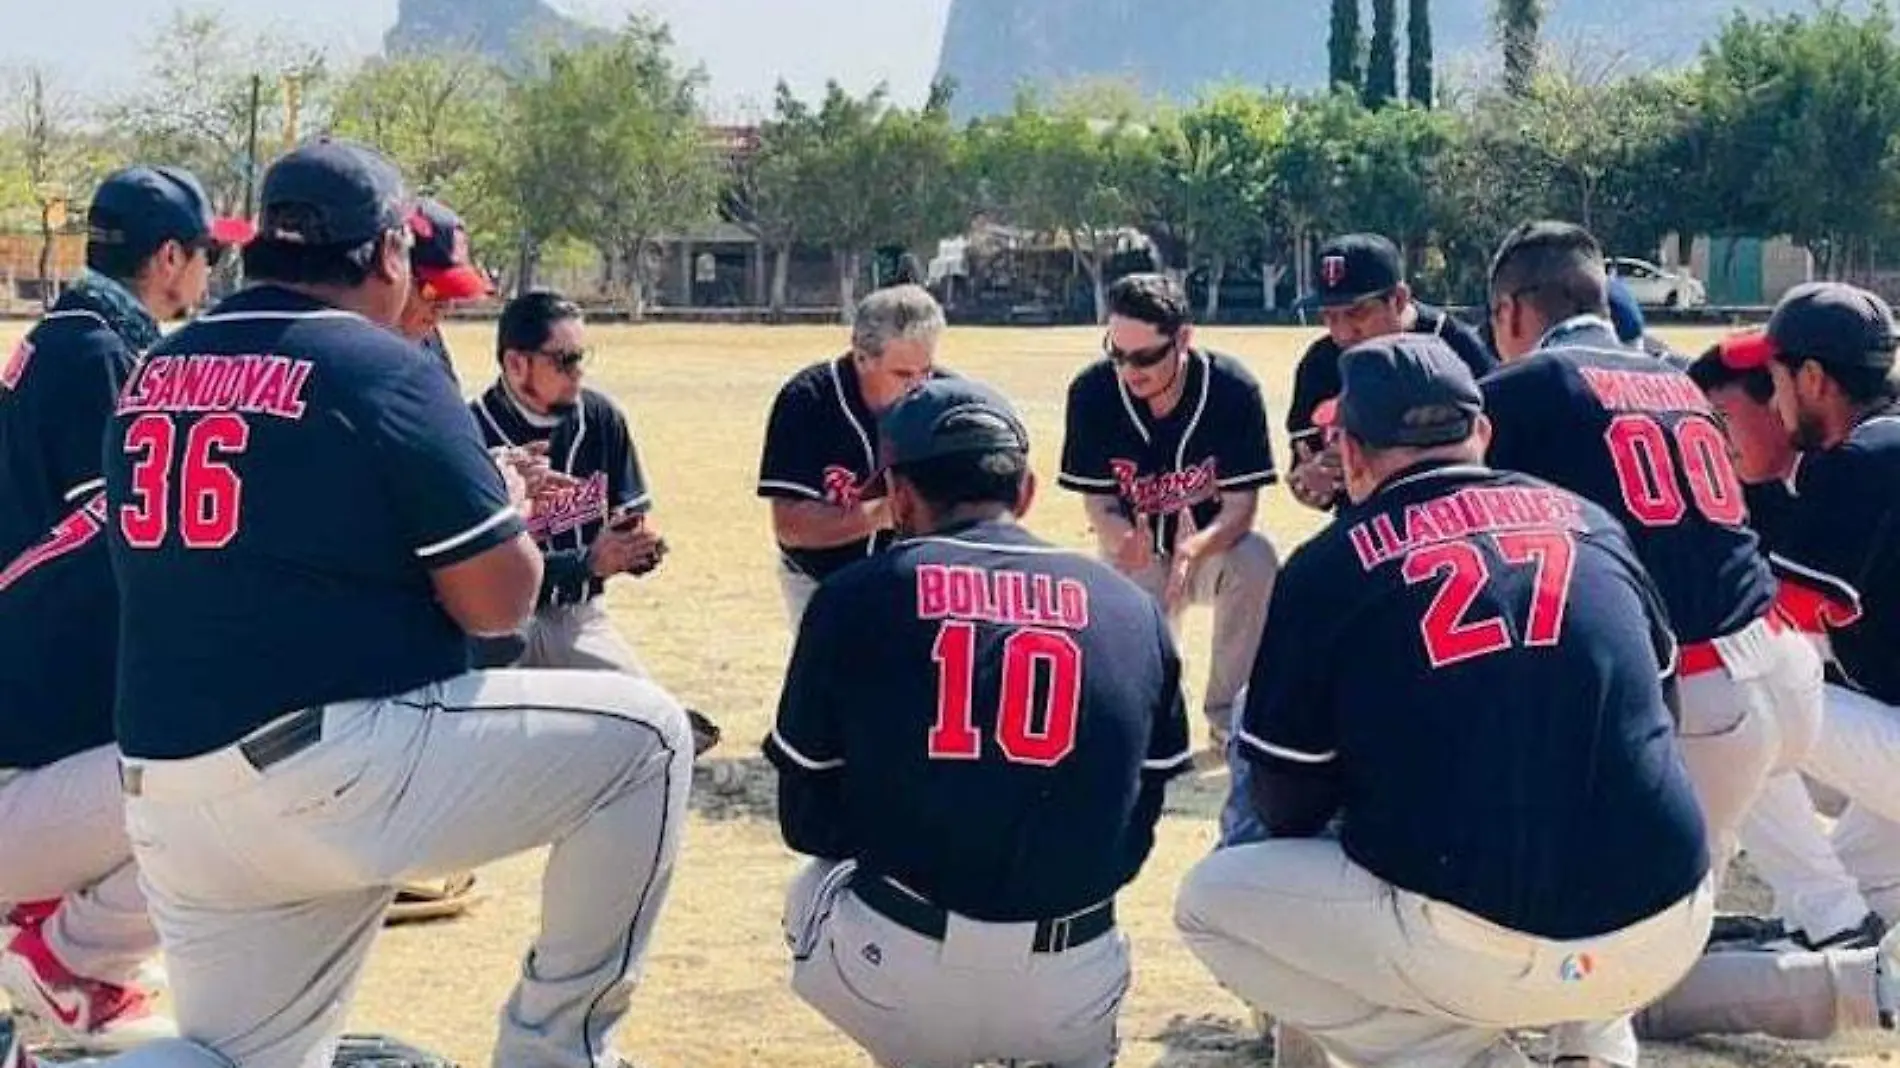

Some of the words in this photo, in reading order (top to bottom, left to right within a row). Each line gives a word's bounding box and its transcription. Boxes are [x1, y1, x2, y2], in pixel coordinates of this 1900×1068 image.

[121, 412, 250, 549] 36
[1604, 414, 1747, 526] 00
[917, 564, 1088, 629] BOLILLO
[1402, 530, 1576, 669] 27
[928, 619, 1083, 766] 10
